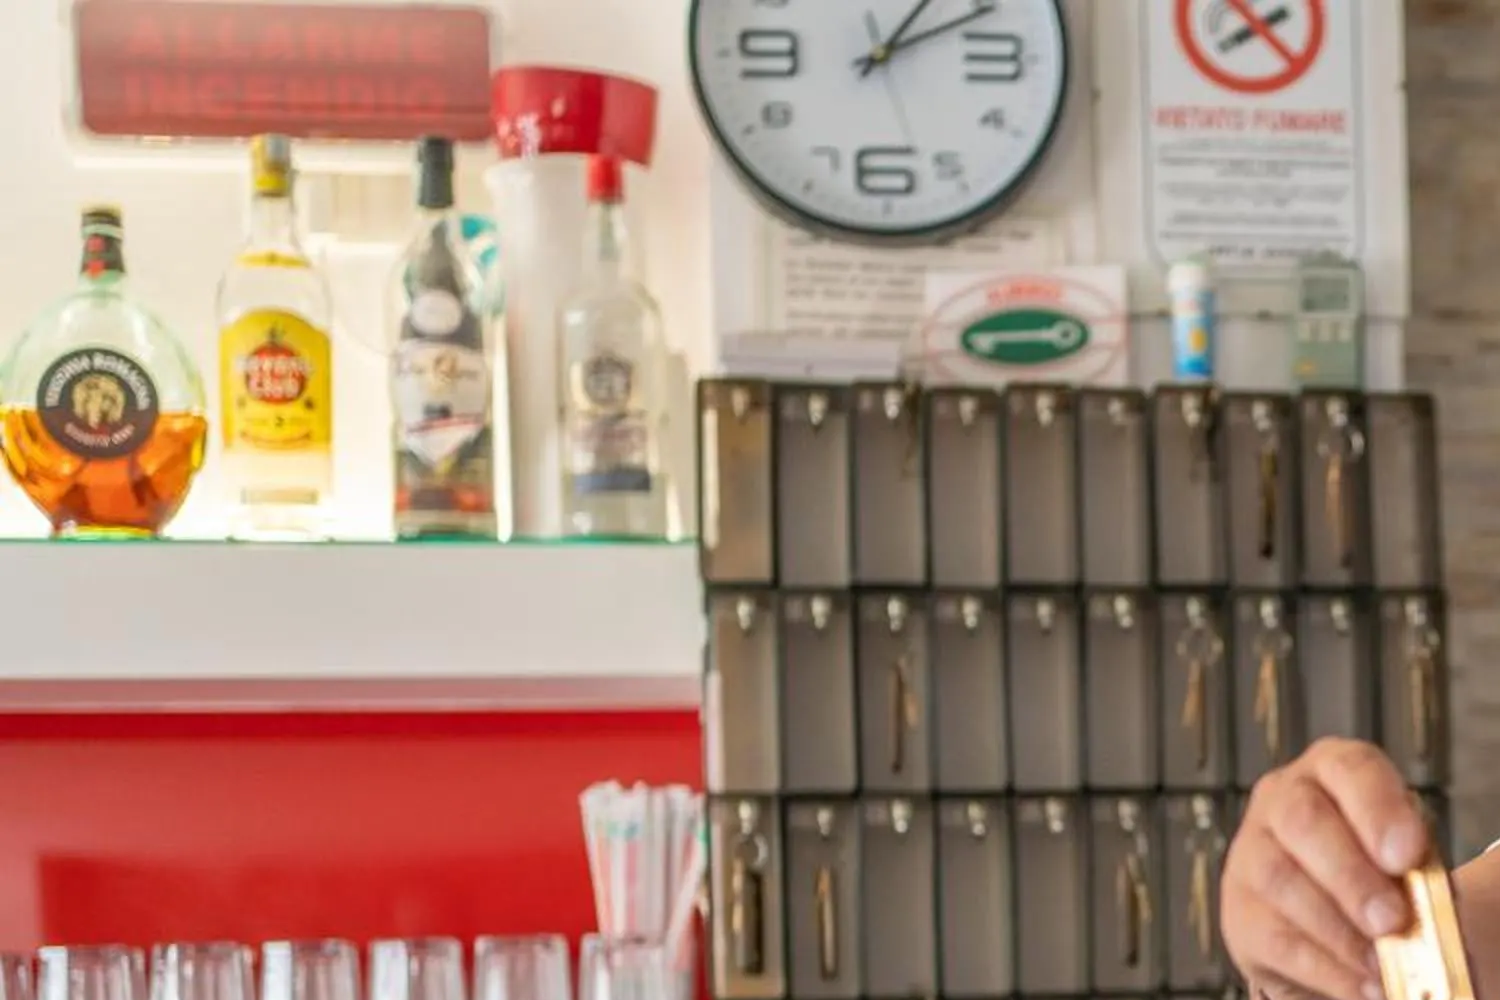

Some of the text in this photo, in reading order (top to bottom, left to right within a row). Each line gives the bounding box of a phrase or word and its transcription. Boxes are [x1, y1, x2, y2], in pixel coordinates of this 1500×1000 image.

[127, 16, 447, 62] ALLARME
[739, 30, 798, 79] 9
[963, 32, 1023, 82] 3
[125, 72, 447, 119] INCENDIO
[1155, 105, 1348, 134] VIETATO FUMARE
[856, 147, 915, 194] 6
